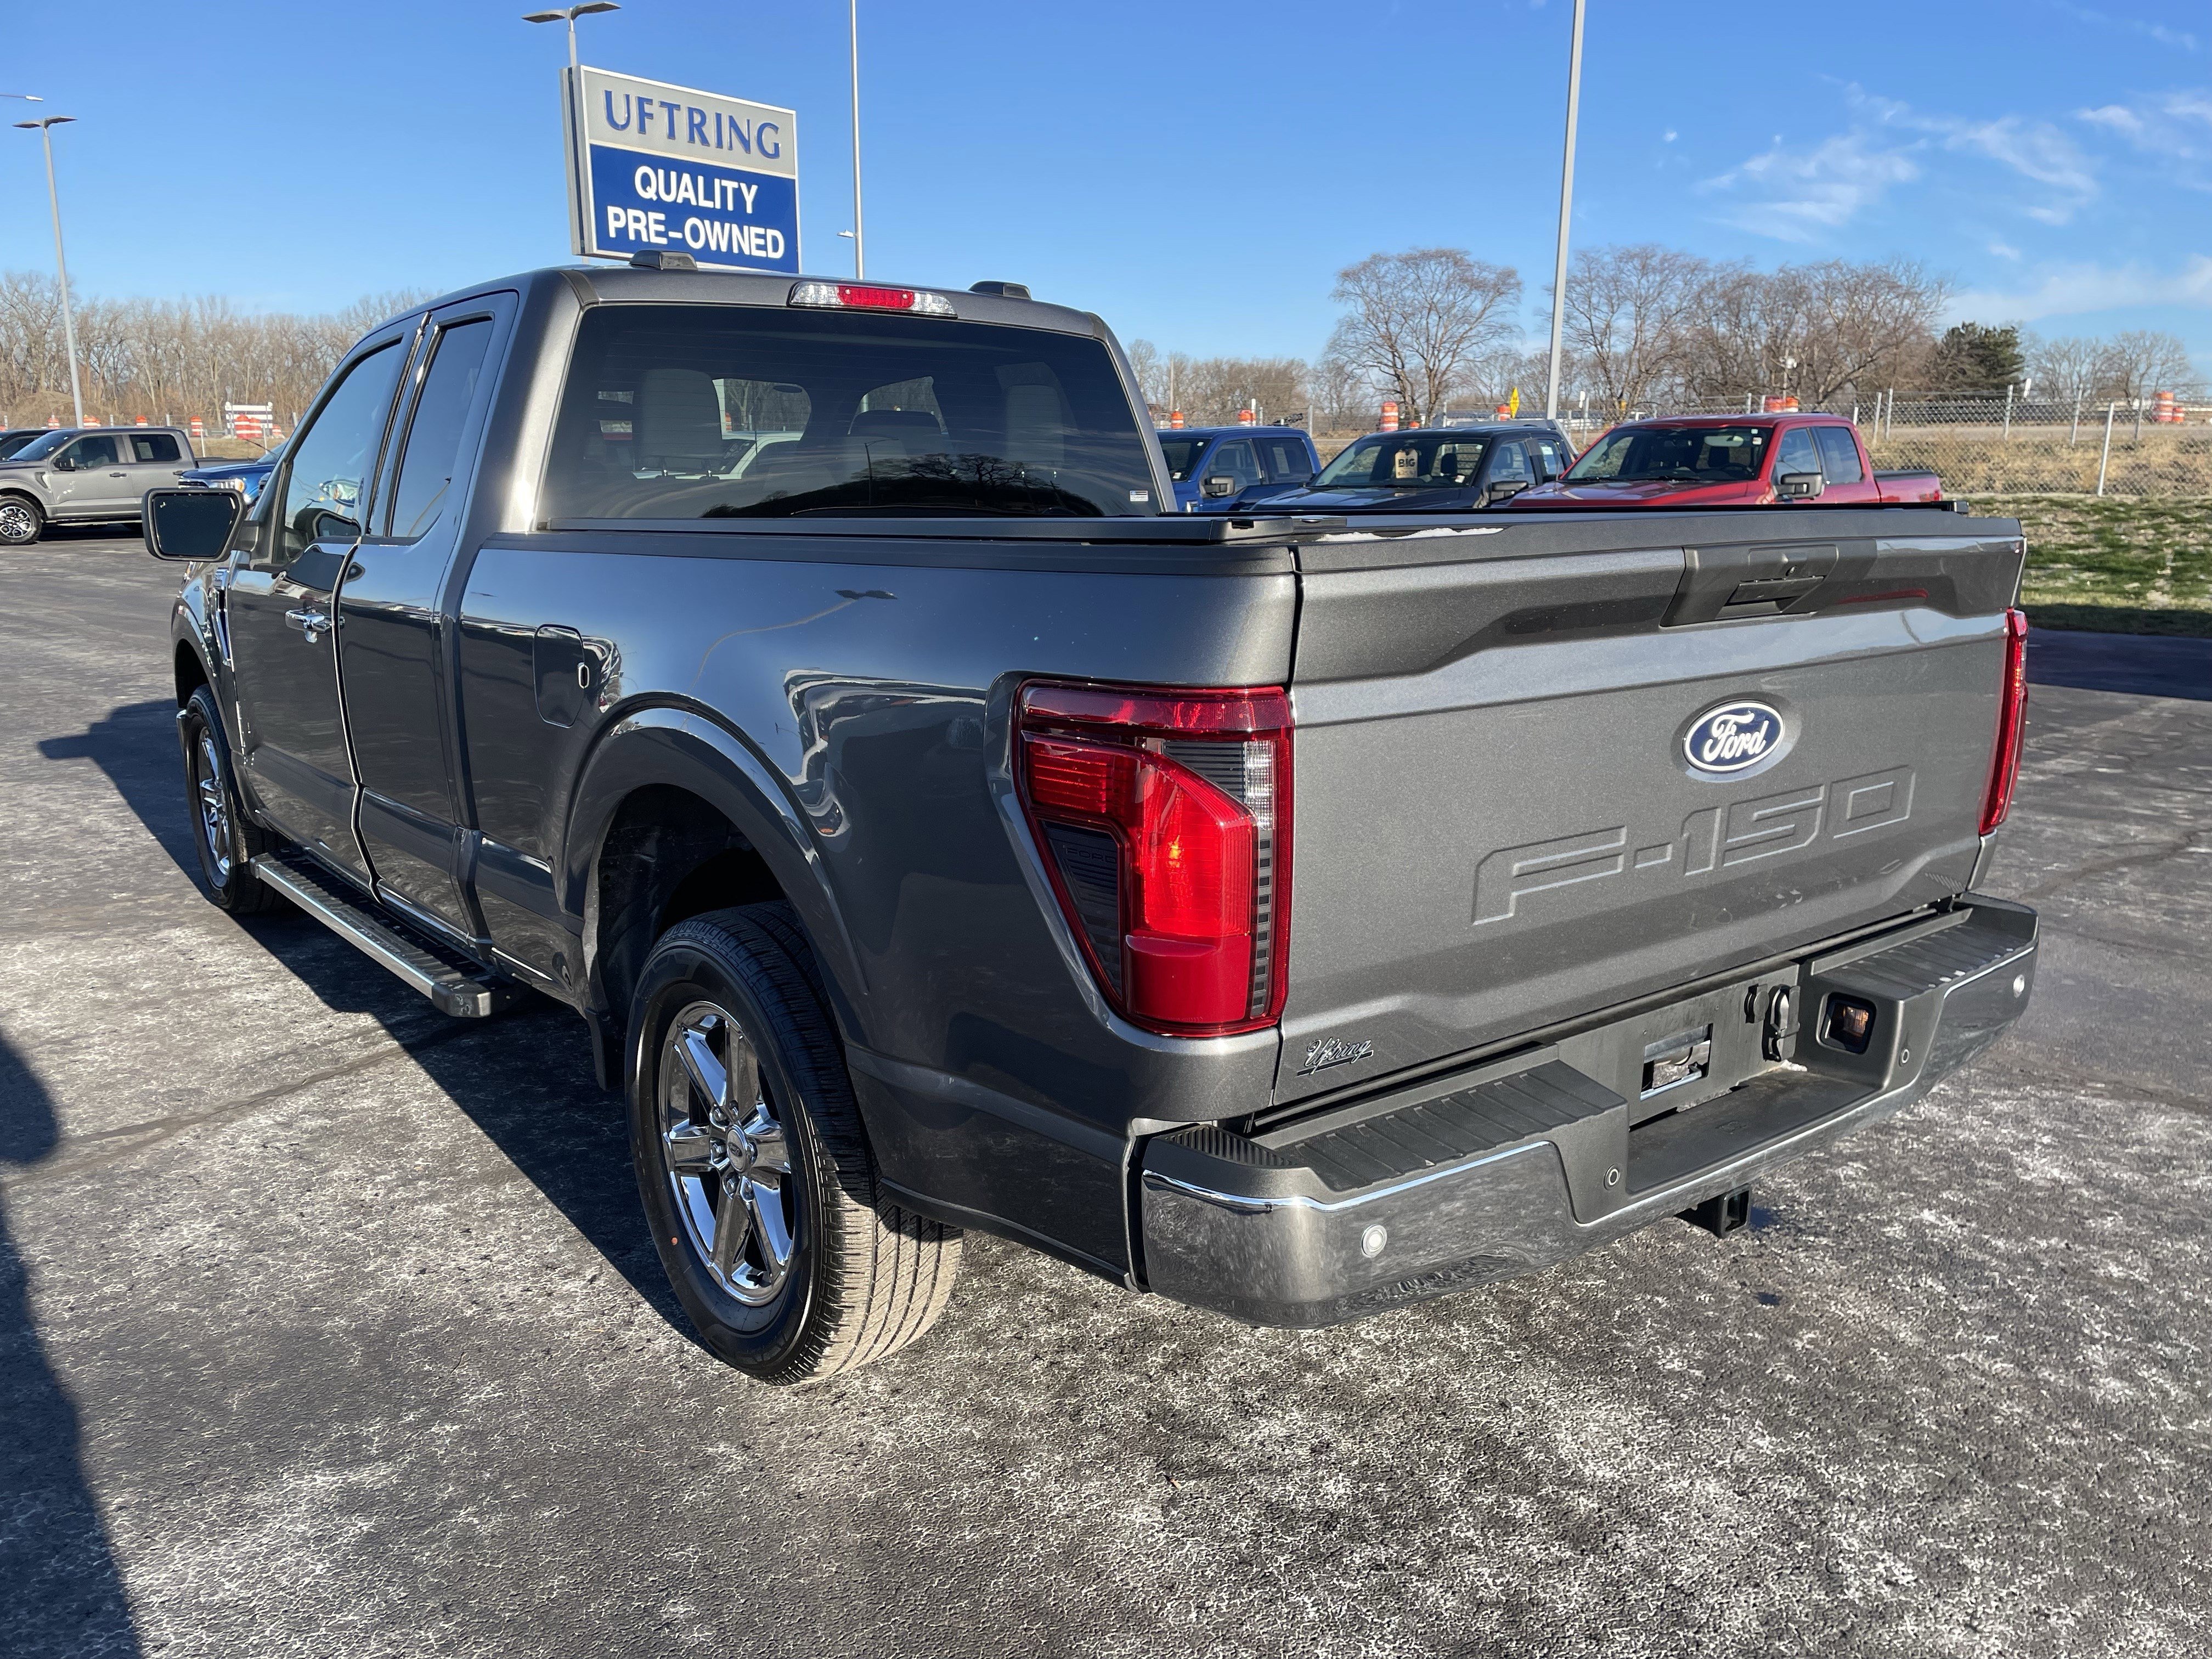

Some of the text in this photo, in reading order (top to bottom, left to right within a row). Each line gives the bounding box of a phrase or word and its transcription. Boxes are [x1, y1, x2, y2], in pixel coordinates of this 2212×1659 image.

[604, 89, 781, 160] UFTRING
[635, 166, 758, 214] QUALITY
[607, 205, 785, 259] PRE-OWNED
[1398, 458, 1415, 467] BIG
[1703, 713, 1770, 762] Ford
[1066, 847, 1117, 864] FORD
[1472, 765, 1917, 926] F-150
